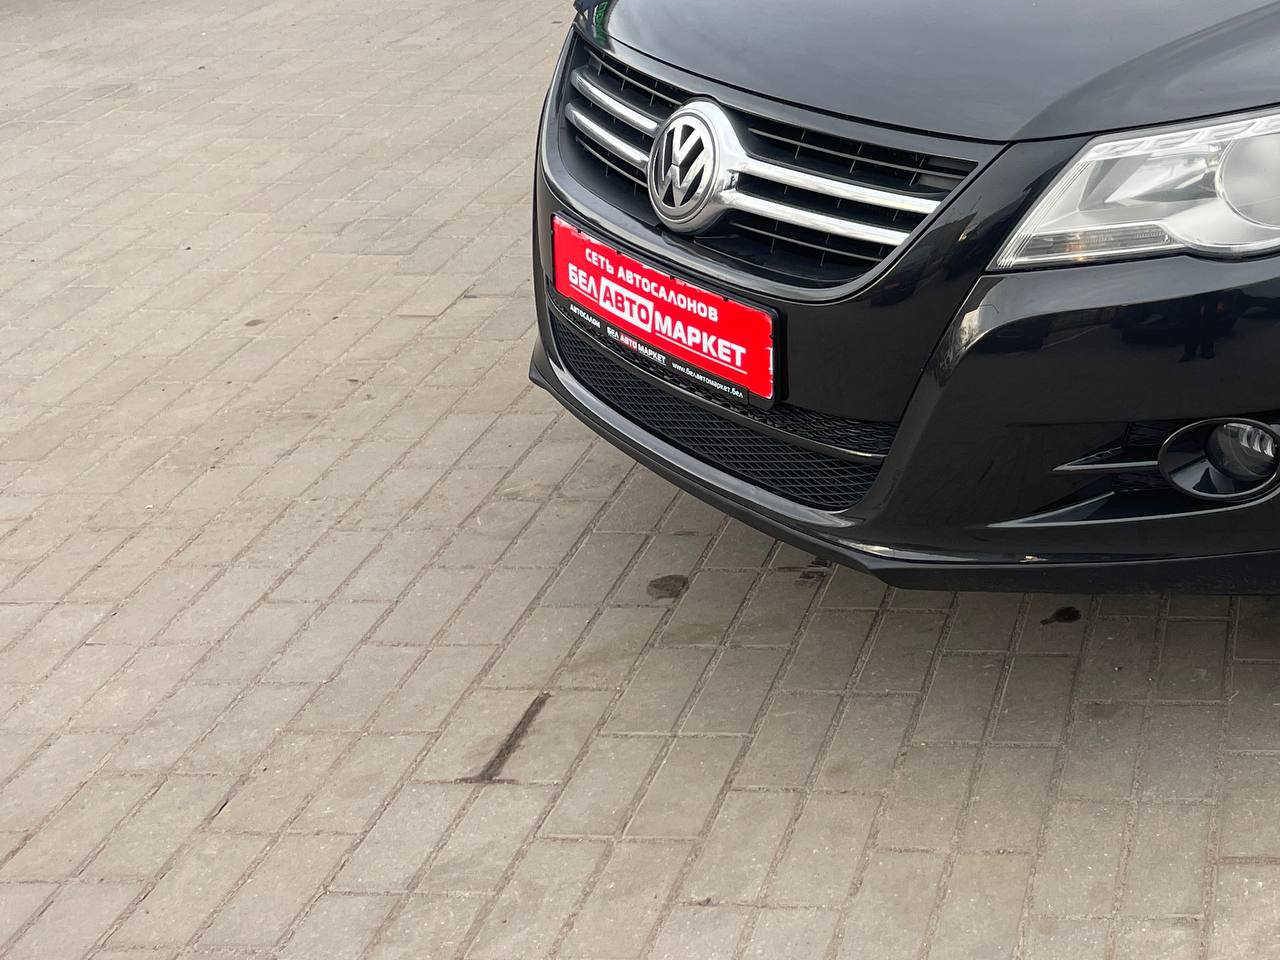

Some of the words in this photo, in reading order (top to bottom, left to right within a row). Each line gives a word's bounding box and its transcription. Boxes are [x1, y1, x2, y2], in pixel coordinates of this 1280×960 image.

[568, 263, 599, 299] БЕЛ
[603, 289, 651, 324] АВТО
[654, 311, 747, 368] МАРКЕТ
[585, 248, 614, 274] СЕТЬ
[617, 266, 719, 322] АВТОСАЛОНОВ
[570, 304, 601, 329] АВТОСАЛОН
[607, 327, 620, 341] БЕЛ
[620, 334, 638, 350] АВТО
[638, 344, 666, 364] МАРКЕТ
